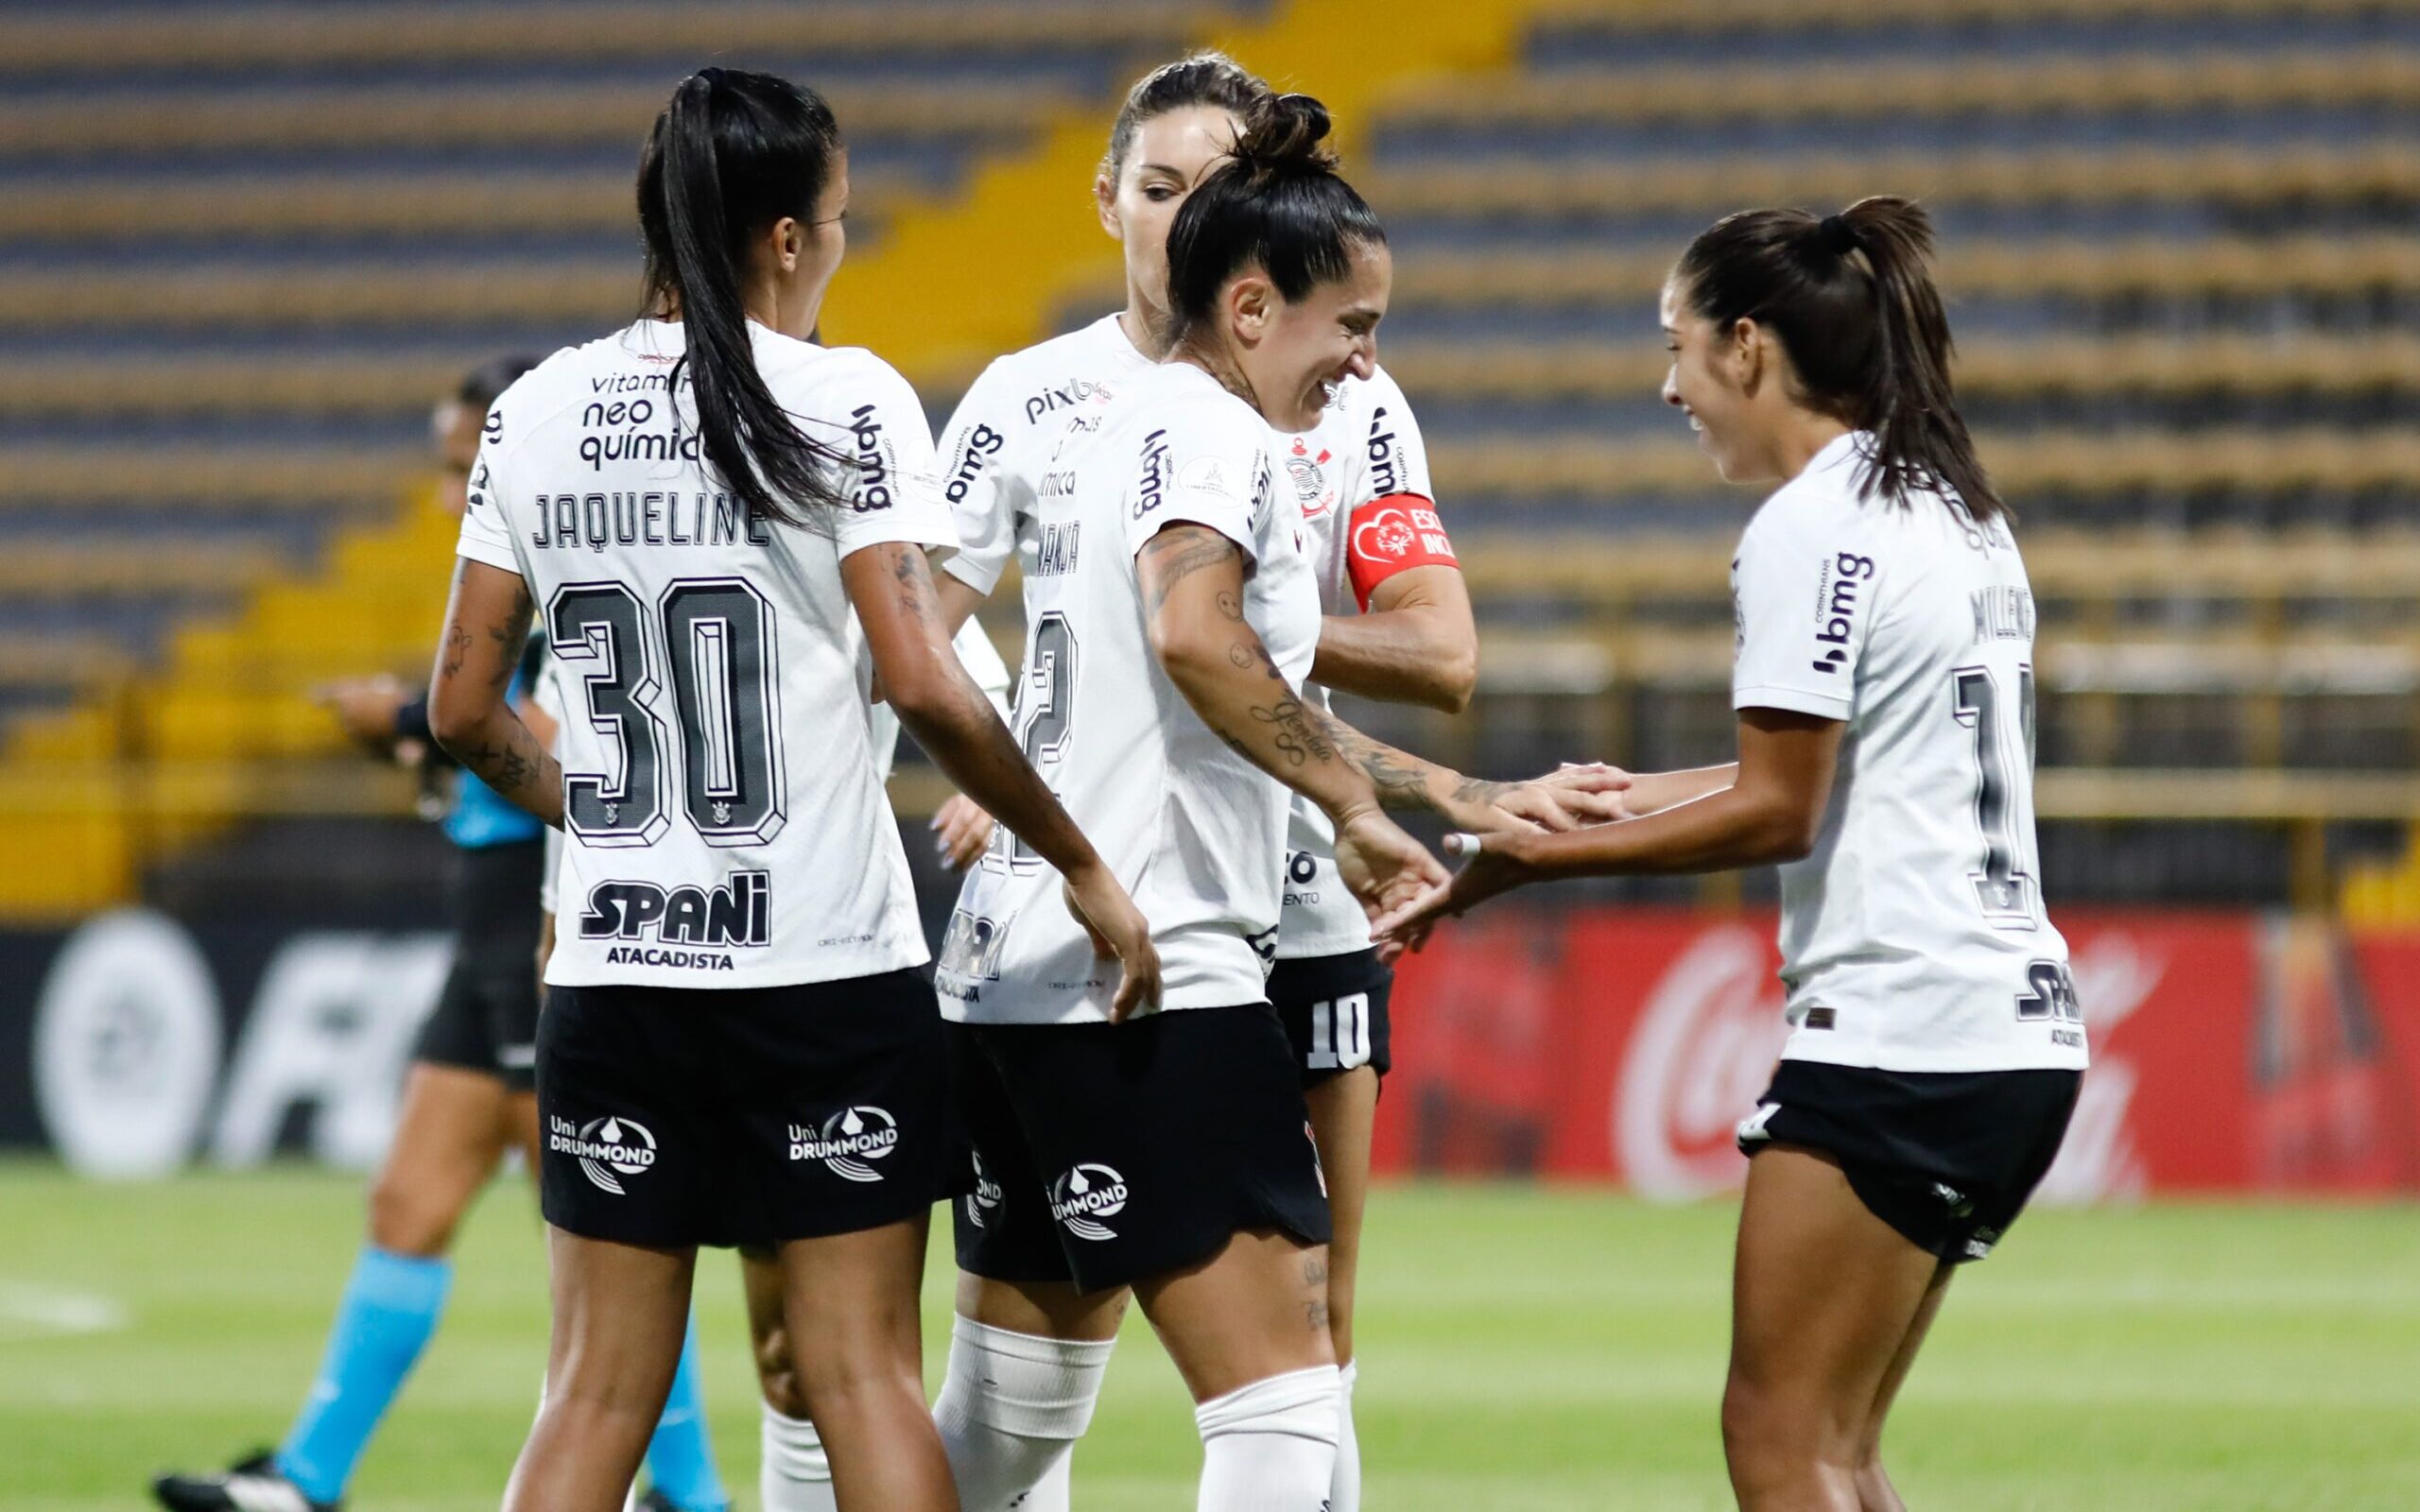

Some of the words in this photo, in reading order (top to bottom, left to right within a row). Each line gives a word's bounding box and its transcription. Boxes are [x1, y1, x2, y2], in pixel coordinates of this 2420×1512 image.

[582, 399, 652, 427] neo
[1026, 378, 1094, 424] pixb
[579, 426, 711, 472] químic
[1368, 432, 1396, 494] bm
[530, 490, 770, 553] JAQUELINE
[1815, 558, 1831, 624] CORINTHIANS
[1816, 551, 1876, 644] bmg
[546, 576, 787, 848] 30
[606, 946, 735, 971] ATACADISTA
[1307, 992, 1372, 1069] 10
[550, 1115, 575, 1137] Uni
[788, 1125, 818, 1142] Uni
[790, 1127, 898, 1160] DRUMMOND
[550, 1136, 655, 1165] DRUMMOND
[1052, 1183, 1129, 1223] UMMOND
